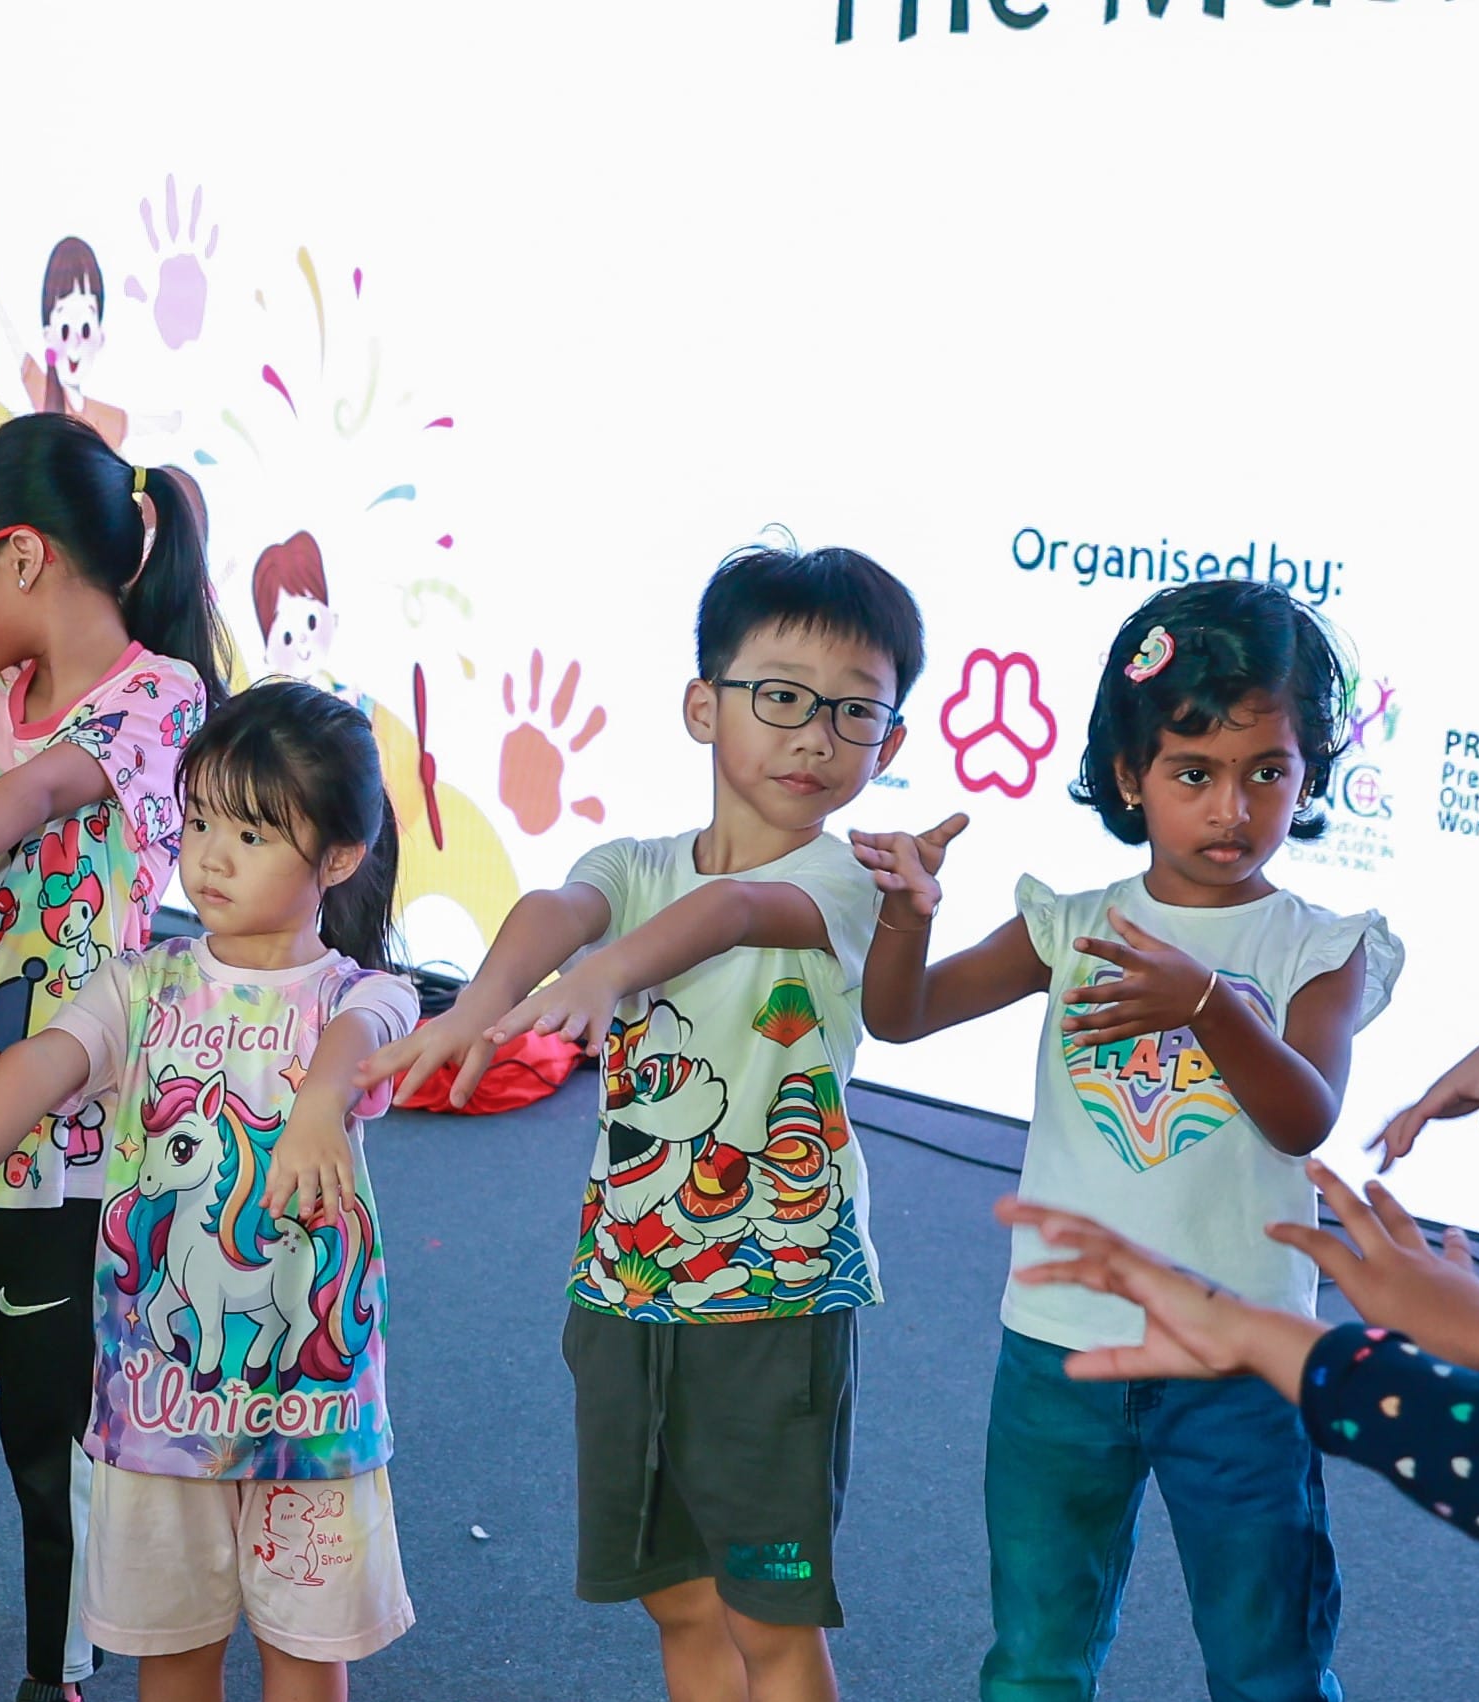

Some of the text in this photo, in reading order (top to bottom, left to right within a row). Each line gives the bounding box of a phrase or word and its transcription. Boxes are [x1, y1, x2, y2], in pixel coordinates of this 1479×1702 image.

[1012, 527, 1256, 587] Organised
[140, 996, 295, 1070] Magical
[1094, 1025, 1221, 1092] HAPP
[124, 1351, 360, 1434] Unicorn
[316, 1532, 344, 1548] Style
[321, 1553, 353, 1567] Show
